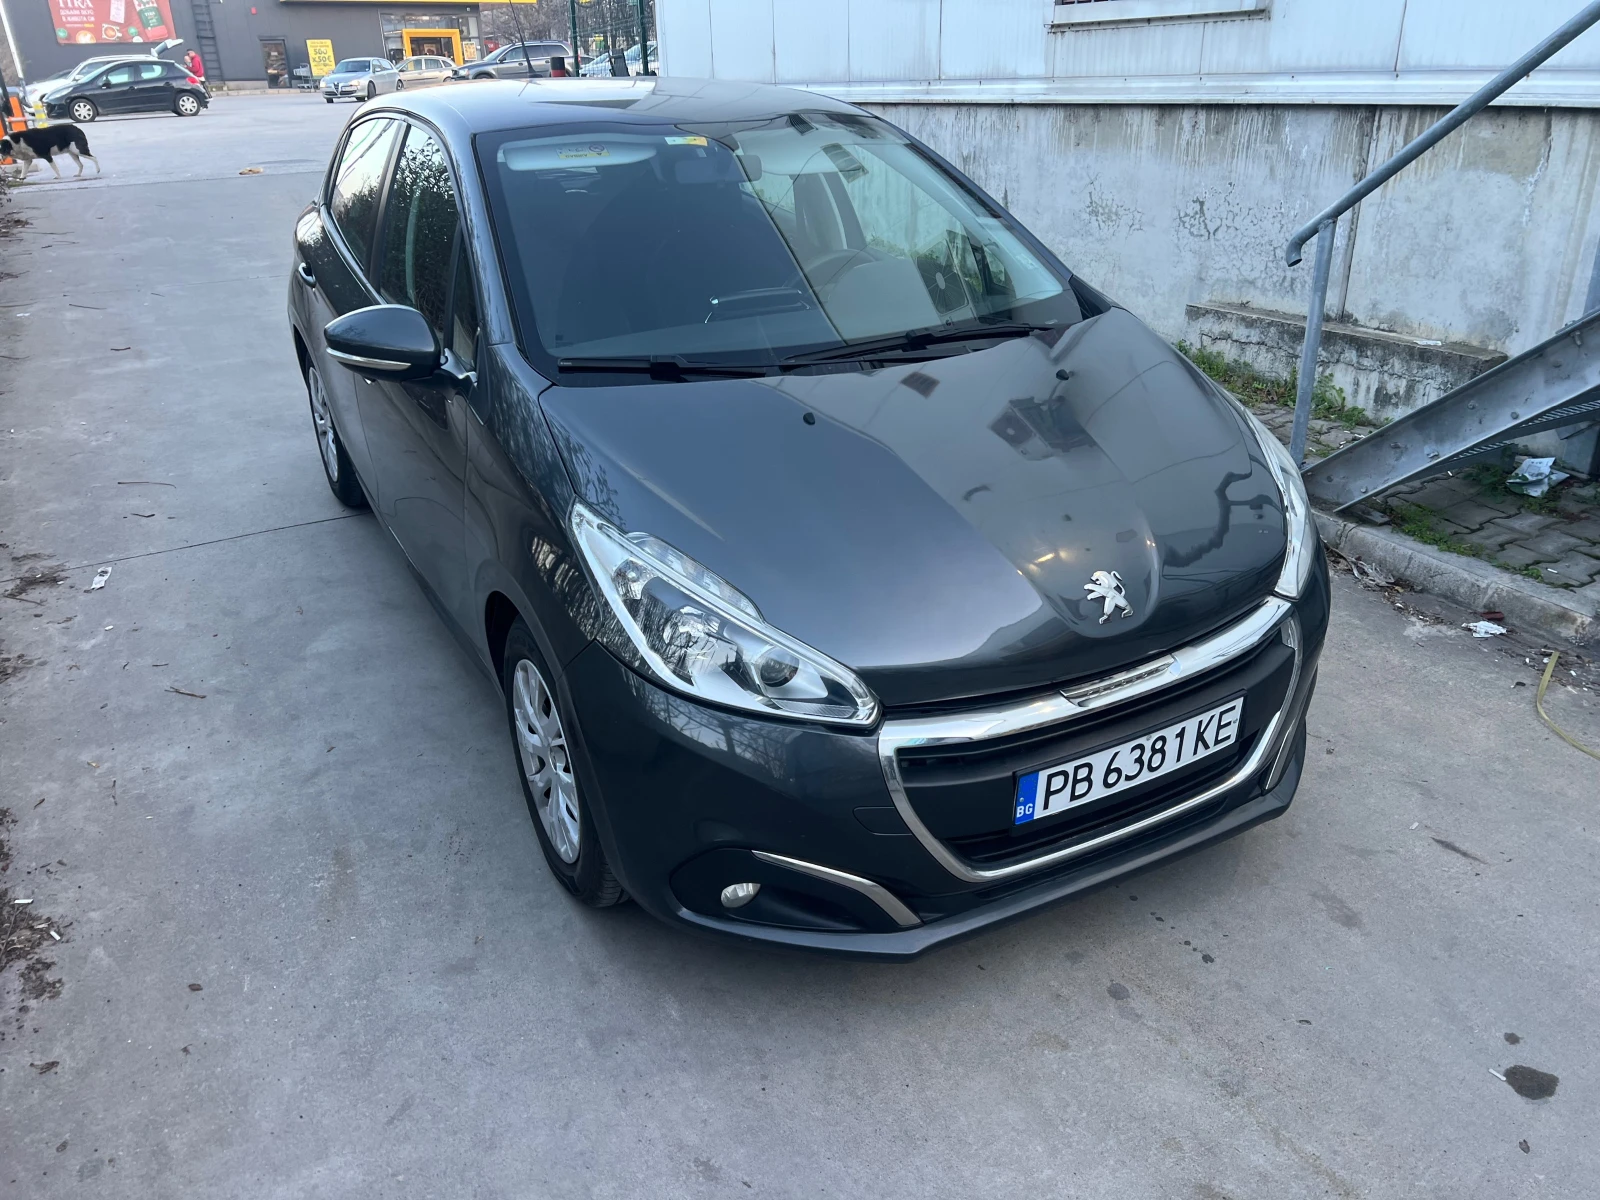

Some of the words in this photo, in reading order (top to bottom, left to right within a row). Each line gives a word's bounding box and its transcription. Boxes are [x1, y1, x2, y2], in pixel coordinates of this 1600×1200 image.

[1042, 762, 1094, 811] PB
[1102, 726, 1186, 789] 6381
[1192, 704, 1238, 756] KE
[1016, 803, 1033, 819] BG
